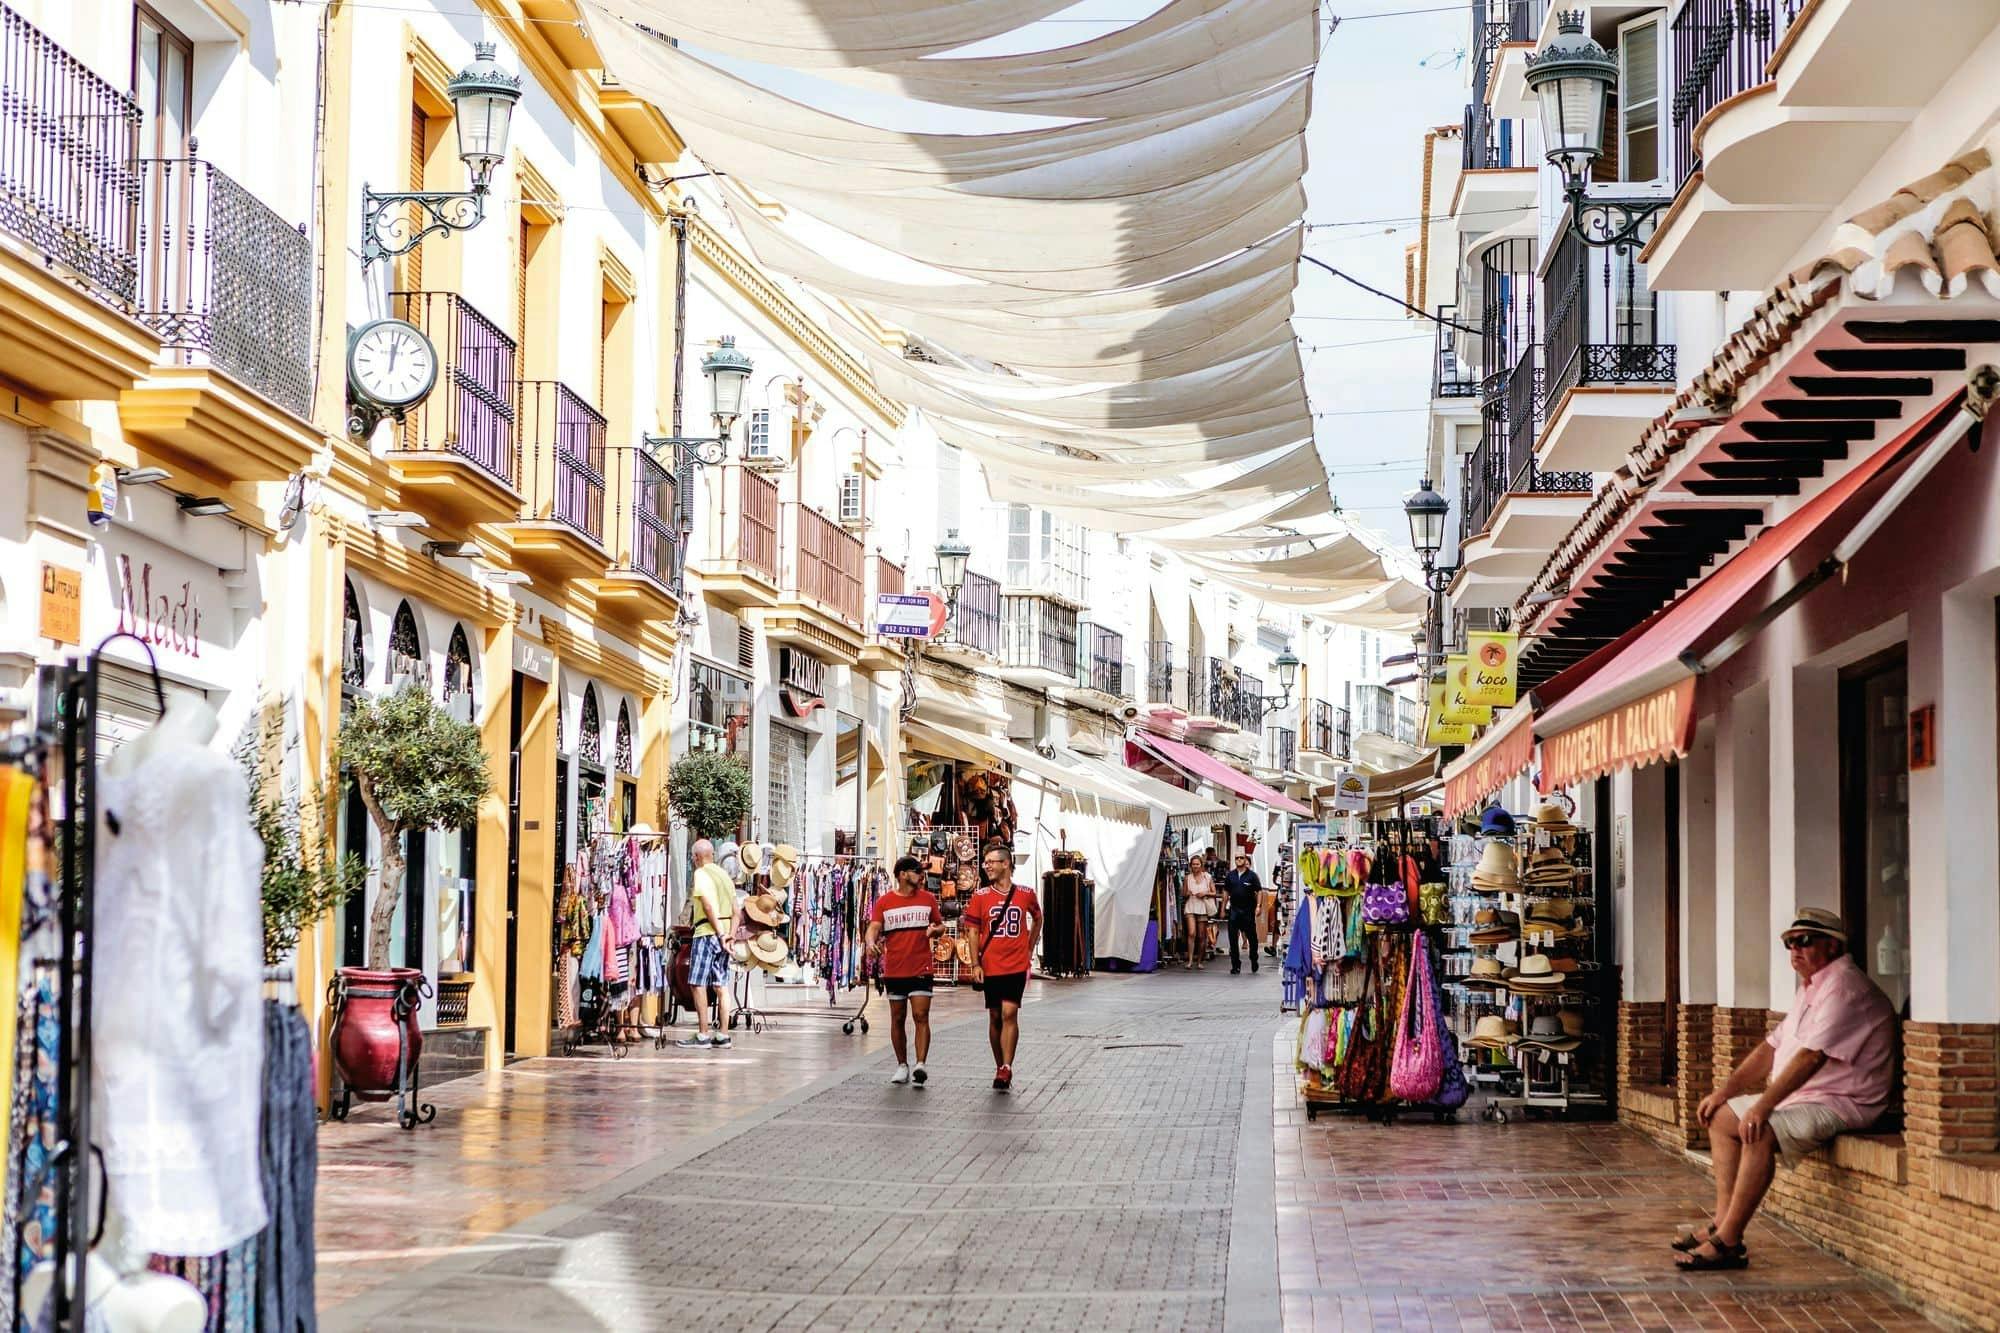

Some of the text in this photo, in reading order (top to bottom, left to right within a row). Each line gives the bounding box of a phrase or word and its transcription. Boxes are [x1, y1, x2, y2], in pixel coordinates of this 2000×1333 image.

[1477, 669, 1508, 686] koco
[1480, 686, 1504, 695] store
[1457, 706, 1480, 714] store
[1441, 726, 1462, 735] store
[887, 911, 930, 925] SPRINGFIELD
[989, 905, 1022, 937] 28
